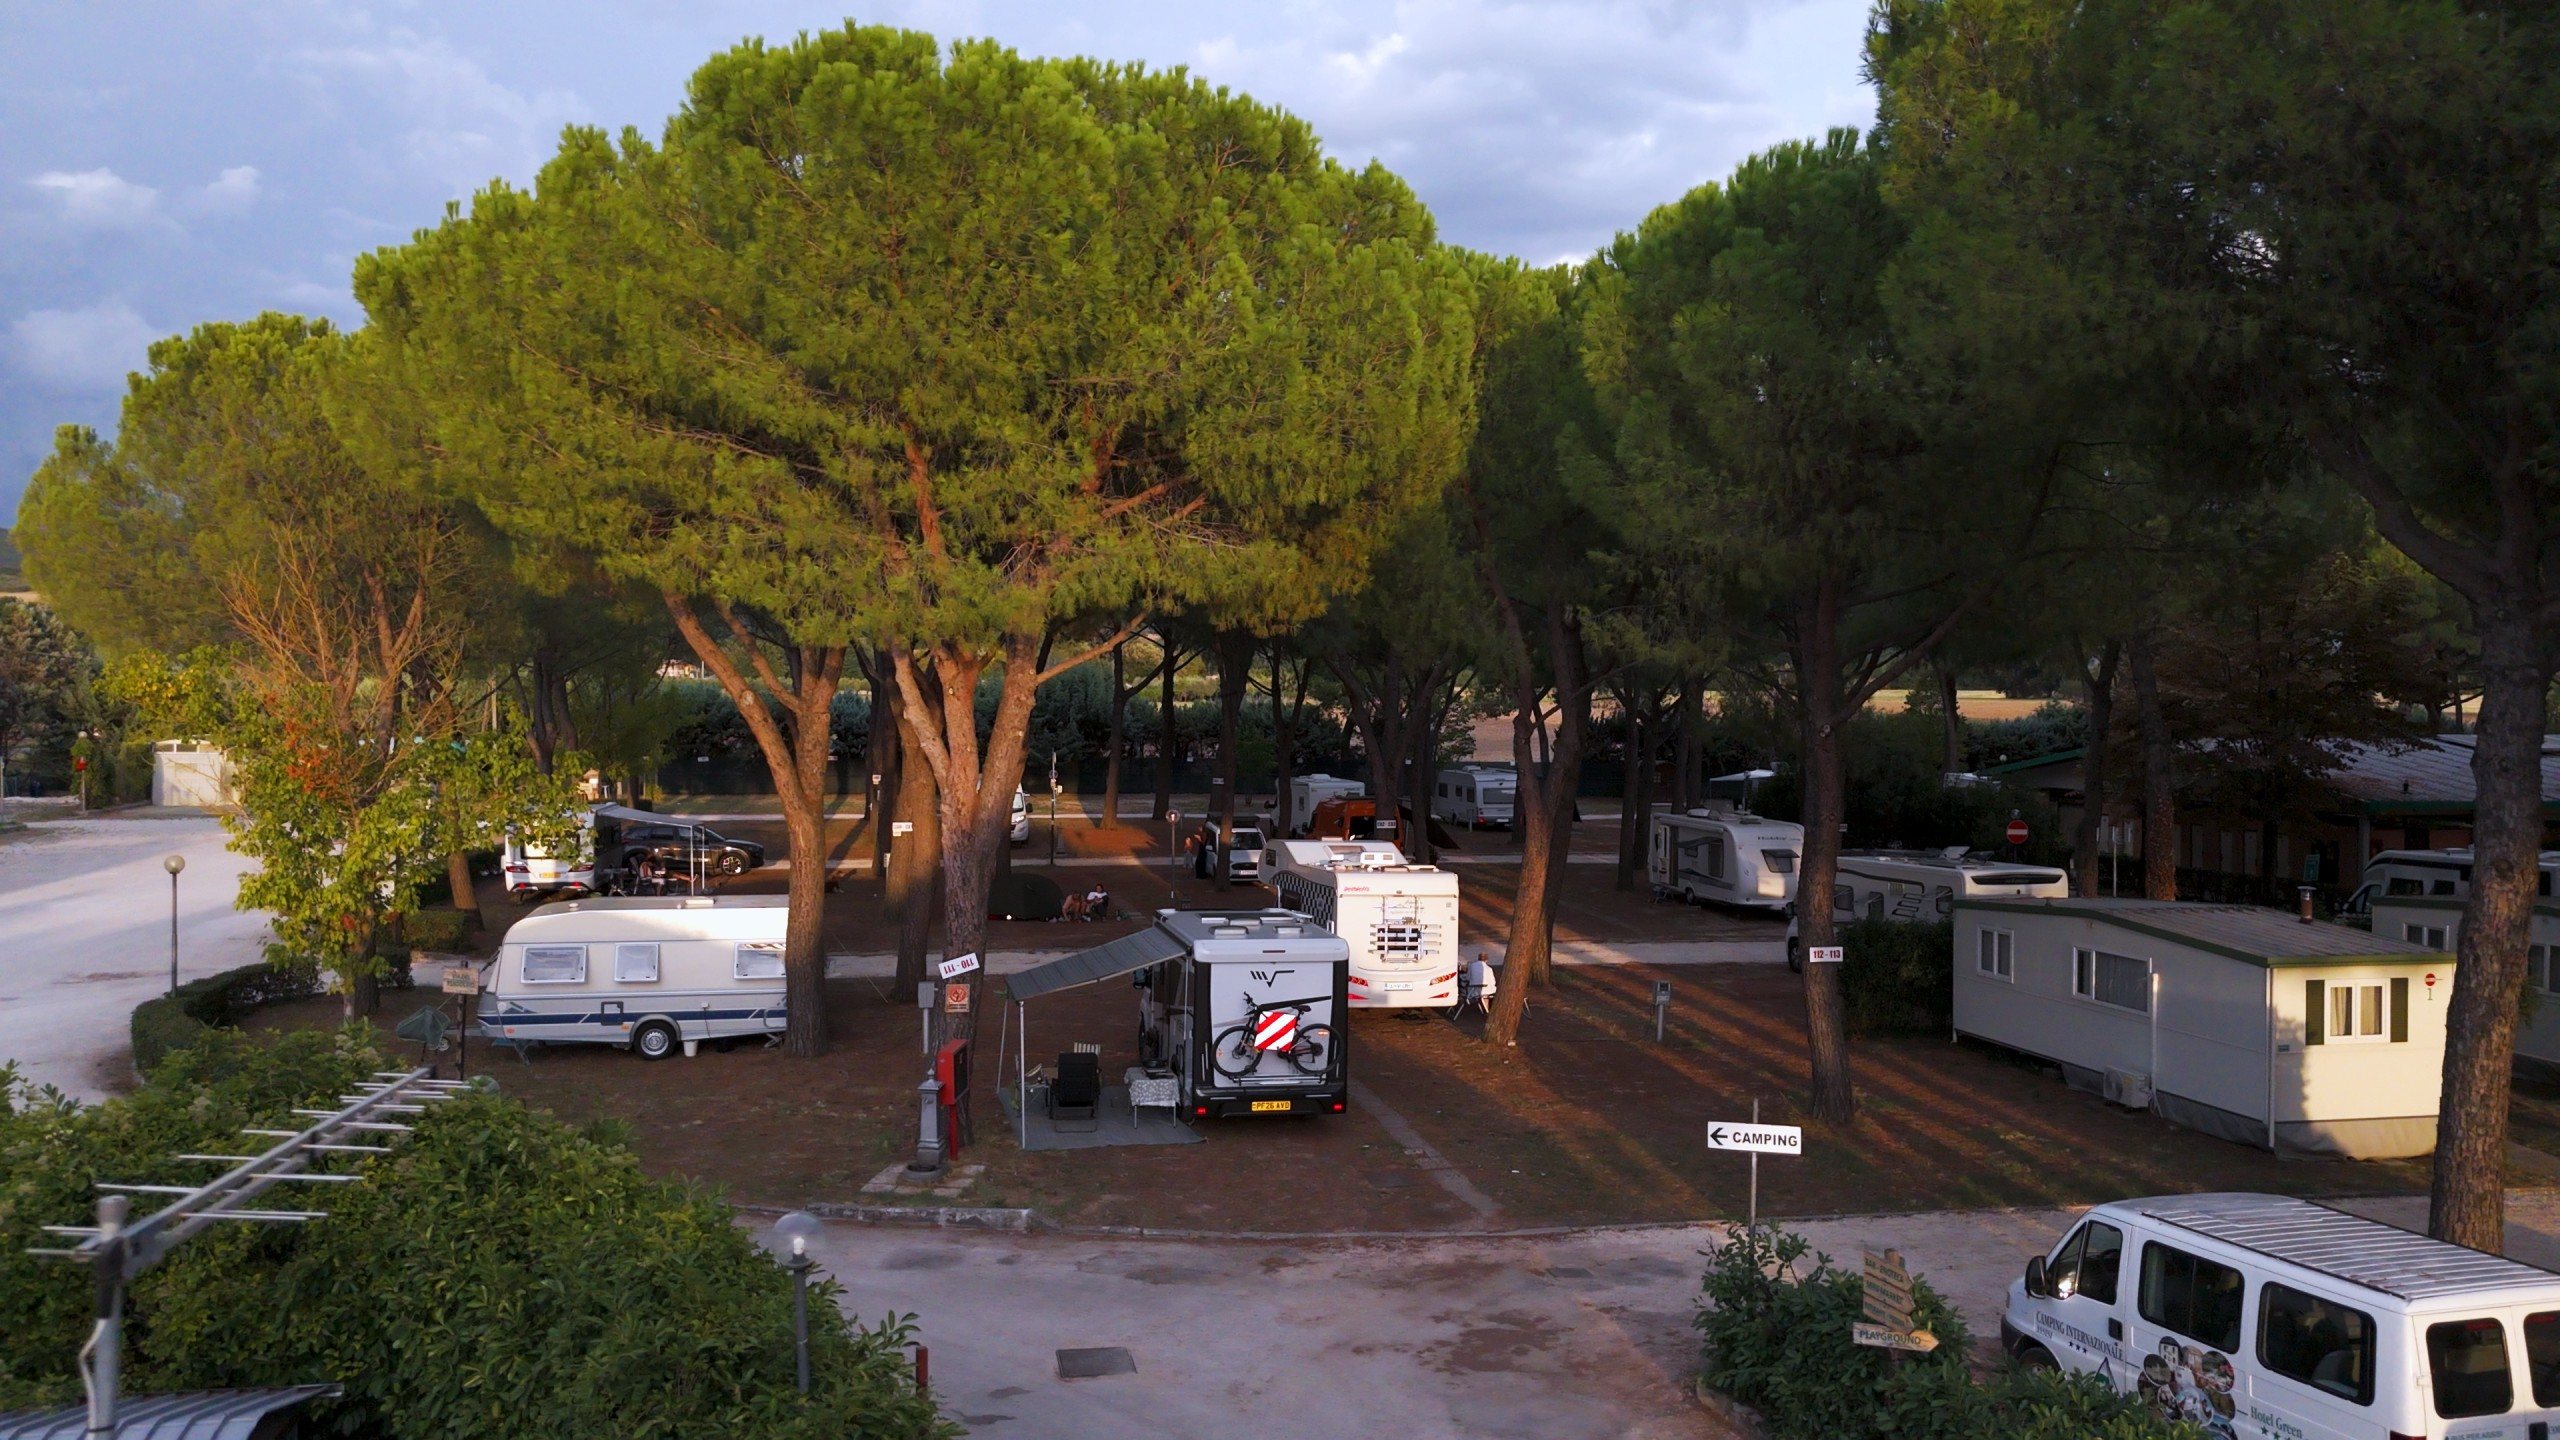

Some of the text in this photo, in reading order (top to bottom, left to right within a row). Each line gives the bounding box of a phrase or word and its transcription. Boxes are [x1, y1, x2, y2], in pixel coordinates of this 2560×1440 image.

[1813, 950, 1824, 958] 112
[1830, 950, 1840, 958] 113
[1732, 1131, 1798, 1147] CAMPING
[1859, 1329, 1922, 1345] PLAYGROUND
[2036, 1311, 2125, 1361] CAMPING INTERNAZIONALE
[2250, 1406, 2303, 1439] Hotel Green
